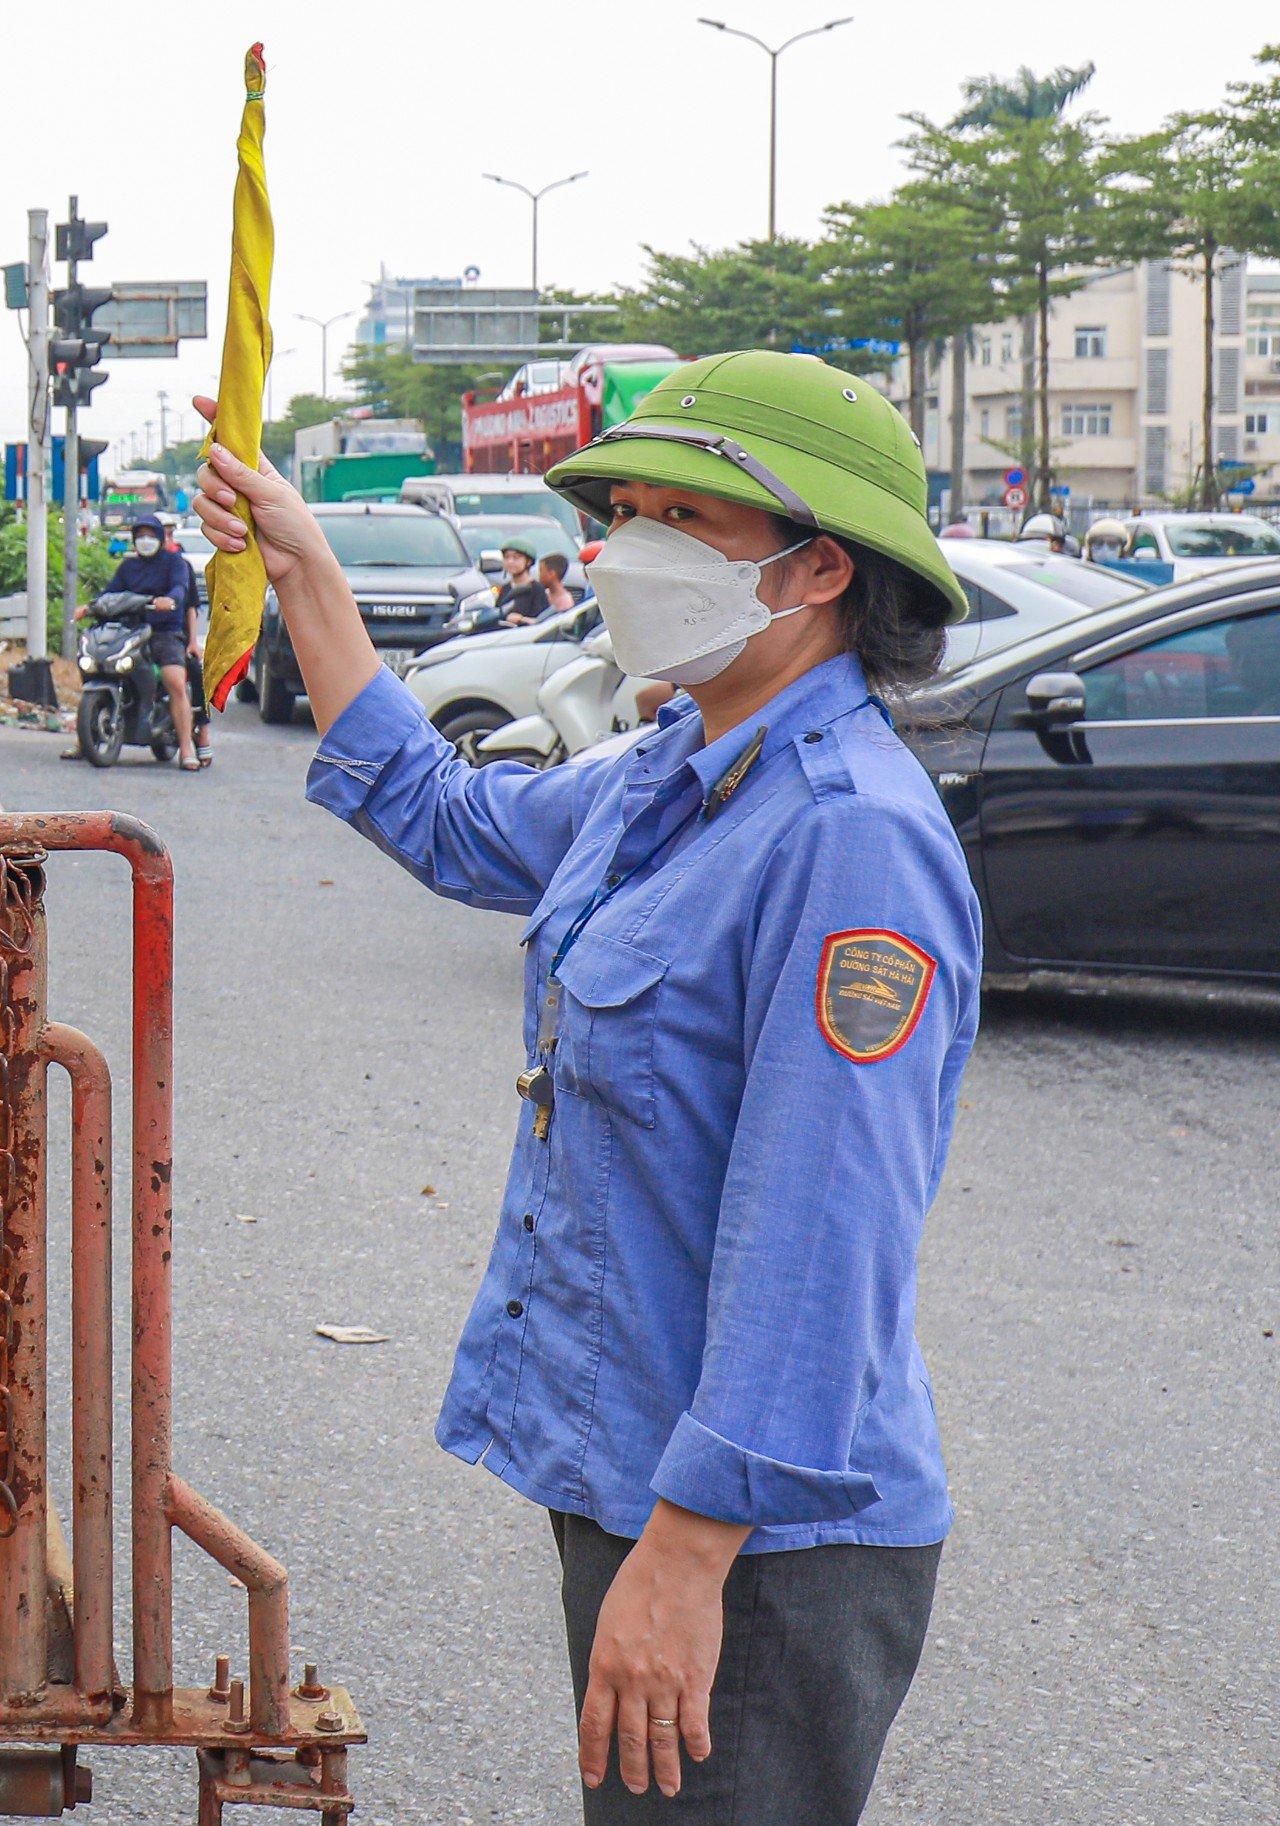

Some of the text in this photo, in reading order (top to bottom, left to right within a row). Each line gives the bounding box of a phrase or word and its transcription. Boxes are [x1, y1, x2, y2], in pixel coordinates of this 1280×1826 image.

[373, 605, 416, 617] ISUZU
[844, 946, 869, 960] CÔNG
[871, 952, 882, 962] TY
